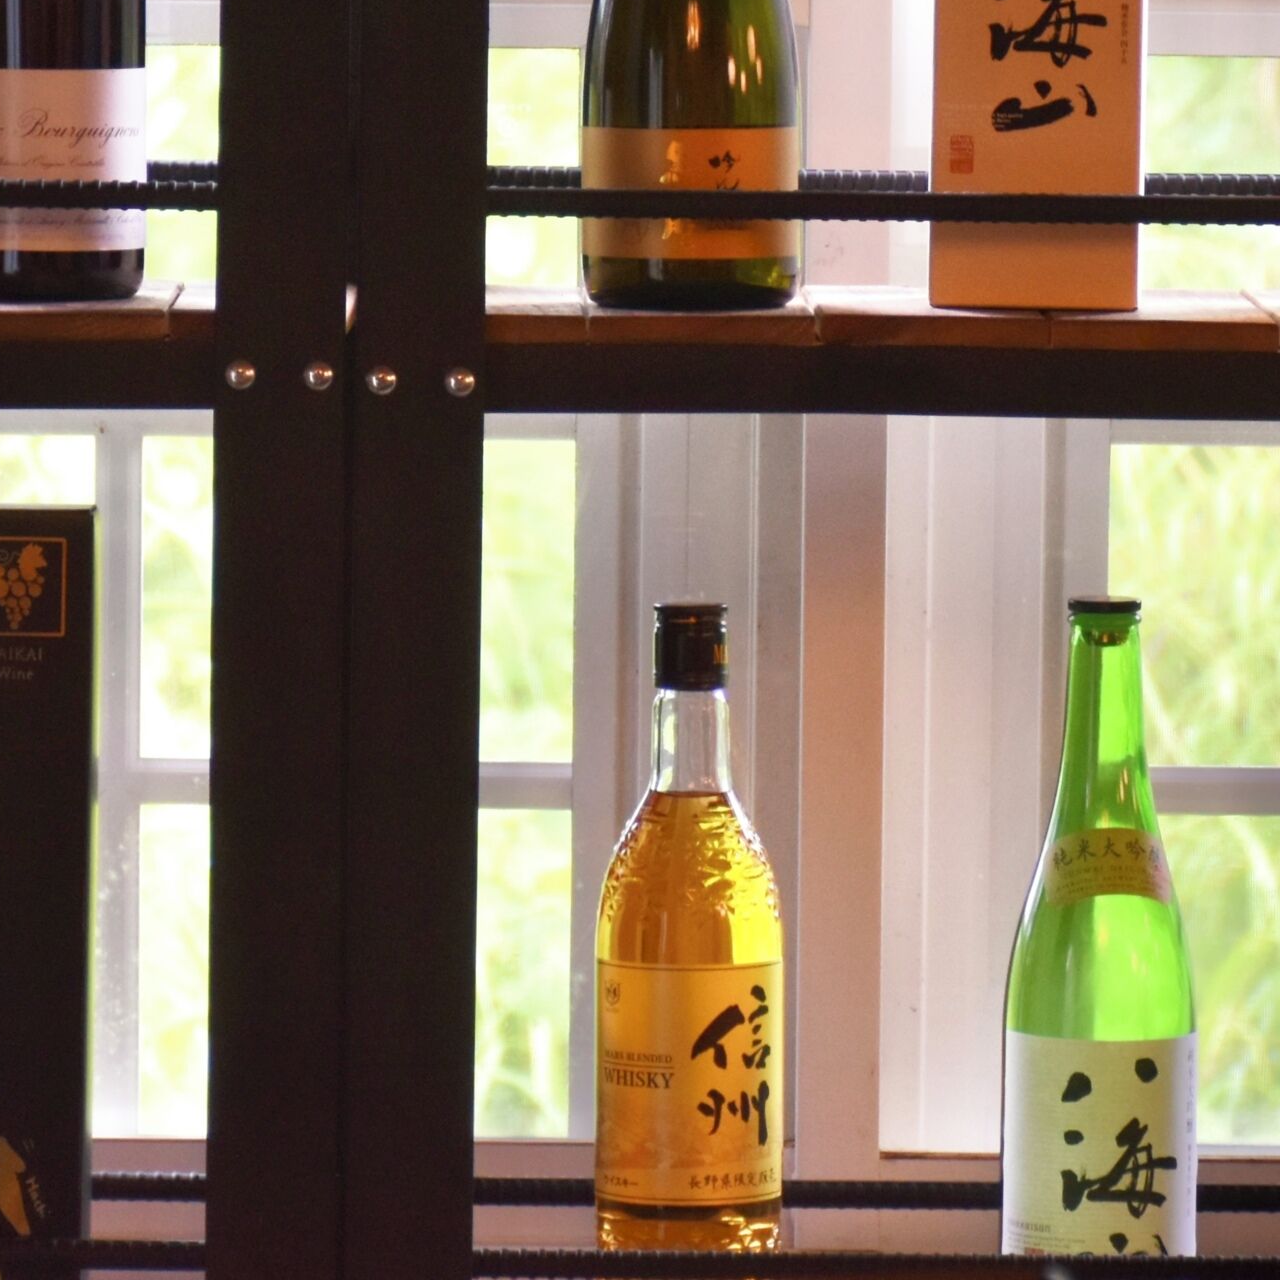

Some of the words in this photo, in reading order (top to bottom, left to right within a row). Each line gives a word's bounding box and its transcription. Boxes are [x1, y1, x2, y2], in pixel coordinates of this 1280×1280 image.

[626, 1051, 673, 1064] BLENDED
[690, 985, 771, 1147] 信州
[604, 1066, 675, 1090] WHISKY
